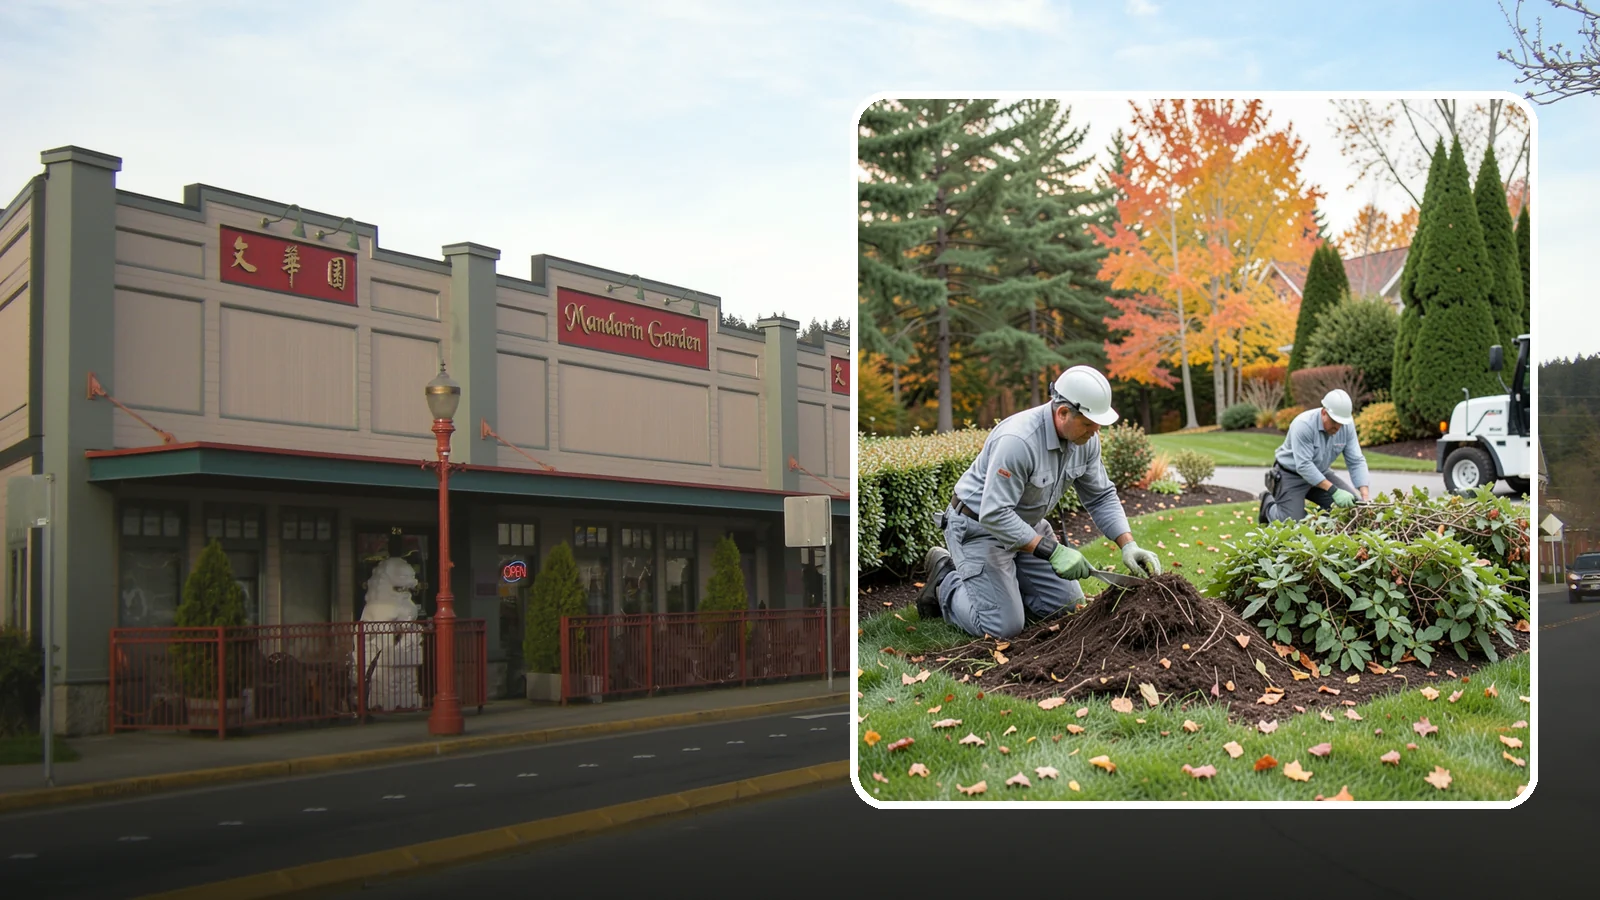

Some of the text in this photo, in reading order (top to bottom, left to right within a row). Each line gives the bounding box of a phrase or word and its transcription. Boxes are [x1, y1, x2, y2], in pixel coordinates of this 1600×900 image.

[231, 236, 346, 291] 文華園
[564, 302, 702, 352] Mandarin Garden
[503, 565, 527, 578] OPEN
